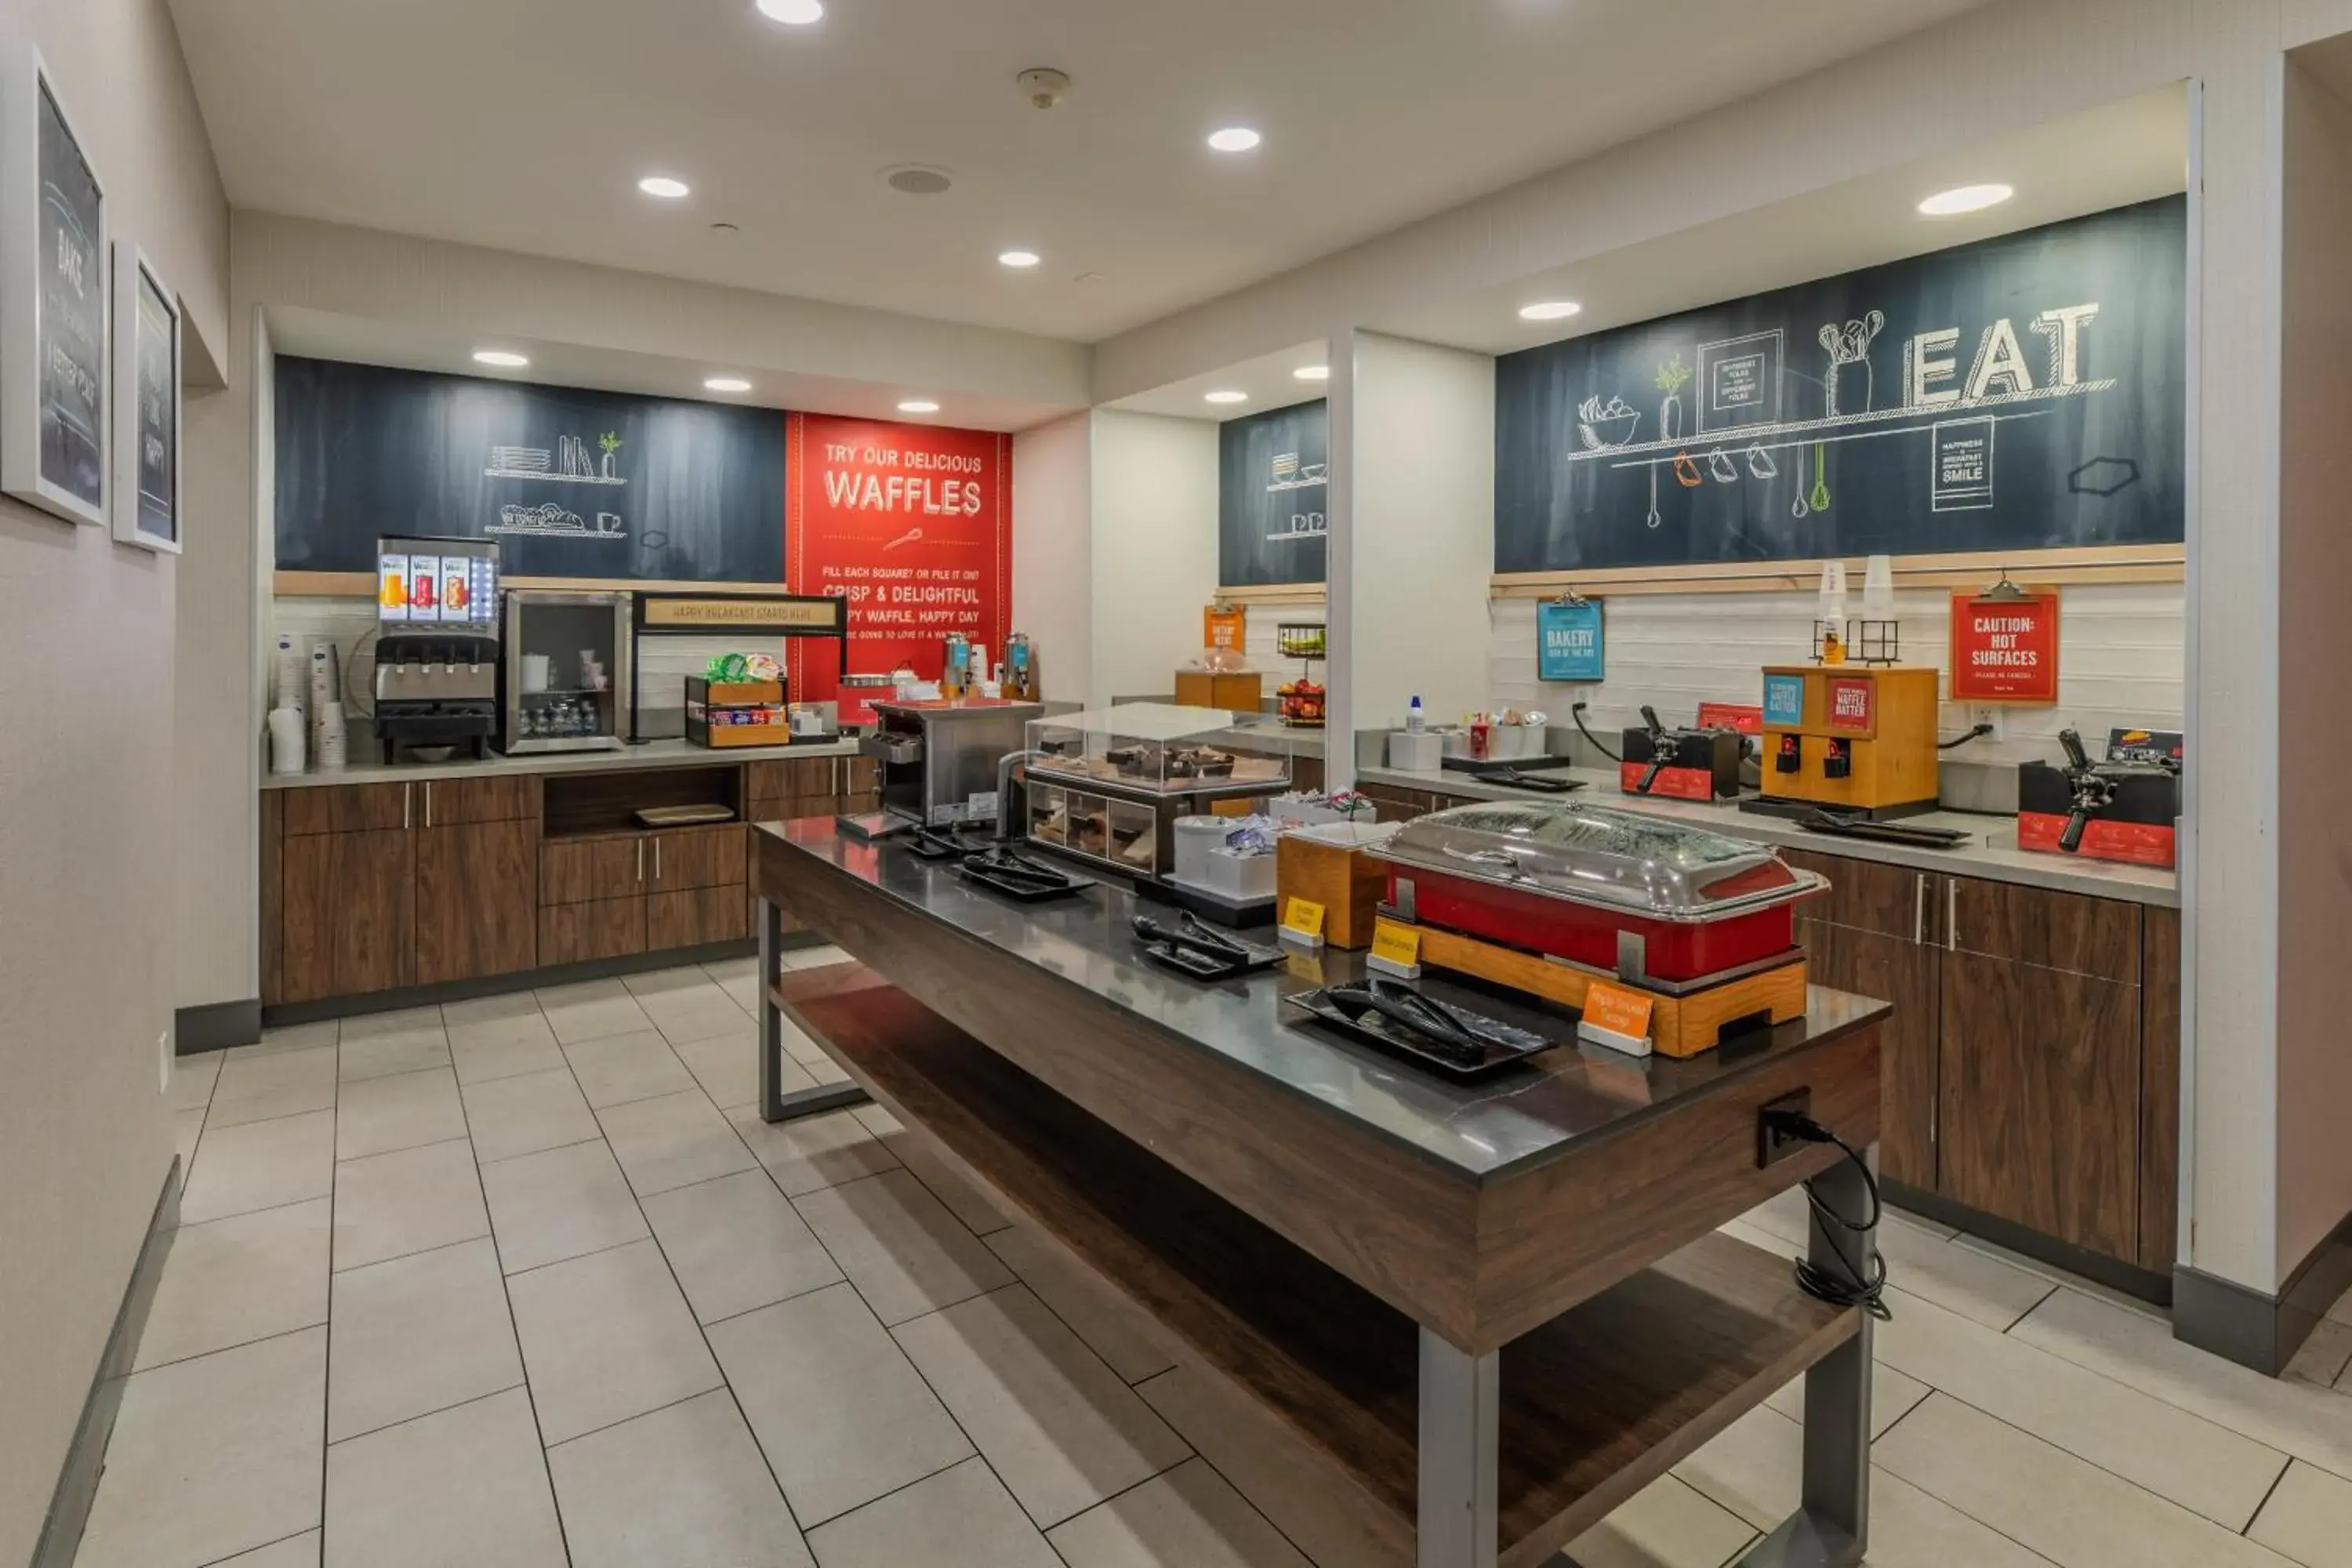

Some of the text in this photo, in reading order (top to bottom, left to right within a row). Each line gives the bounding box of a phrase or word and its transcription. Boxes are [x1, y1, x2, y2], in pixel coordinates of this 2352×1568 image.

[1904, 303, 2099, 408] EAT
[826, 443, 982, 474] TRY OUR DELICIOUS
[1943, 466, 1983, 483] SMILE
[824, 470, 982, 517] WAFFLES
[822, 565, 841, 577] FILL
[844, 566, 869, 578] EACH
[872, 567, 913, 579] SQUARE?
[952, 569, 960, 579] IT
[877, 585, 887, 602] &
[891, 585, 980, 604] DELIGHTFUL
[866, 609, 916, 623] WAFFLE,
[919, 610, 955, 623] HAPPY
[958, 611, 980, 623] DAY
[1974, 616, 2035, 633] CAUTION:
[1547, 630, 1594, 648] BAKERY
[1991, 633, 2017, 650] HOT
[1971, 651, 2038, 666] SURFACES
